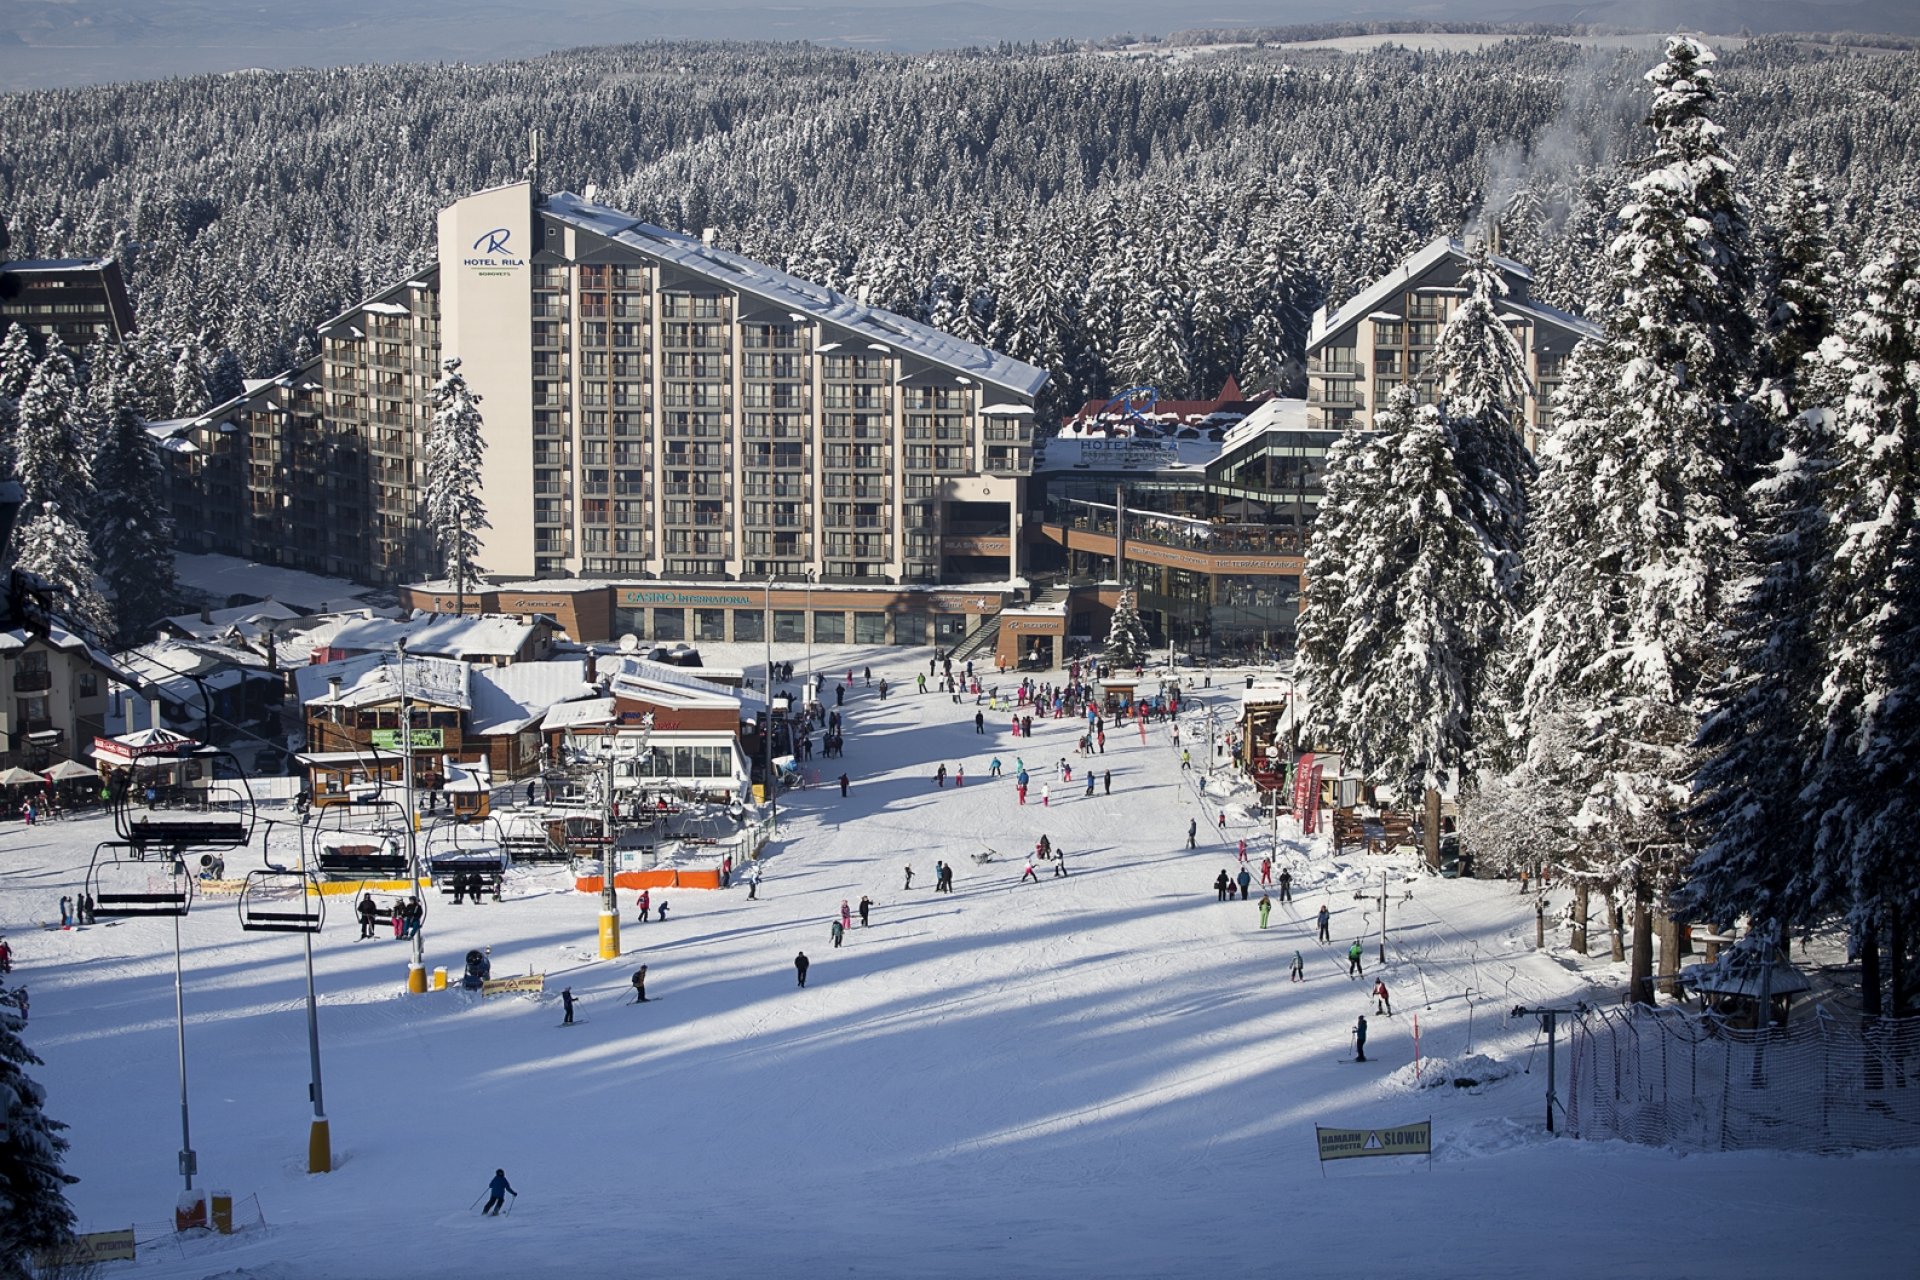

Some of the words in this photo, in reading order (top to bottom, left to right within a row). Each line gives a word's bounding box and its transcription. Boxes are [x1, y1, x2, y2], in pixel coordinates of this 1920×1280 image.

[627, 592, 675, 602] CASINO
[678, 593, 751, 604] INTERNATIONAL
[1295, 791, 1305, 815] RENT
[1300, 763, 1310, 779] SKI
[1322, 1133, 1361, 1144] НАМАЛИ
[1384, 1131, 1427, 1145] SLOWLY
